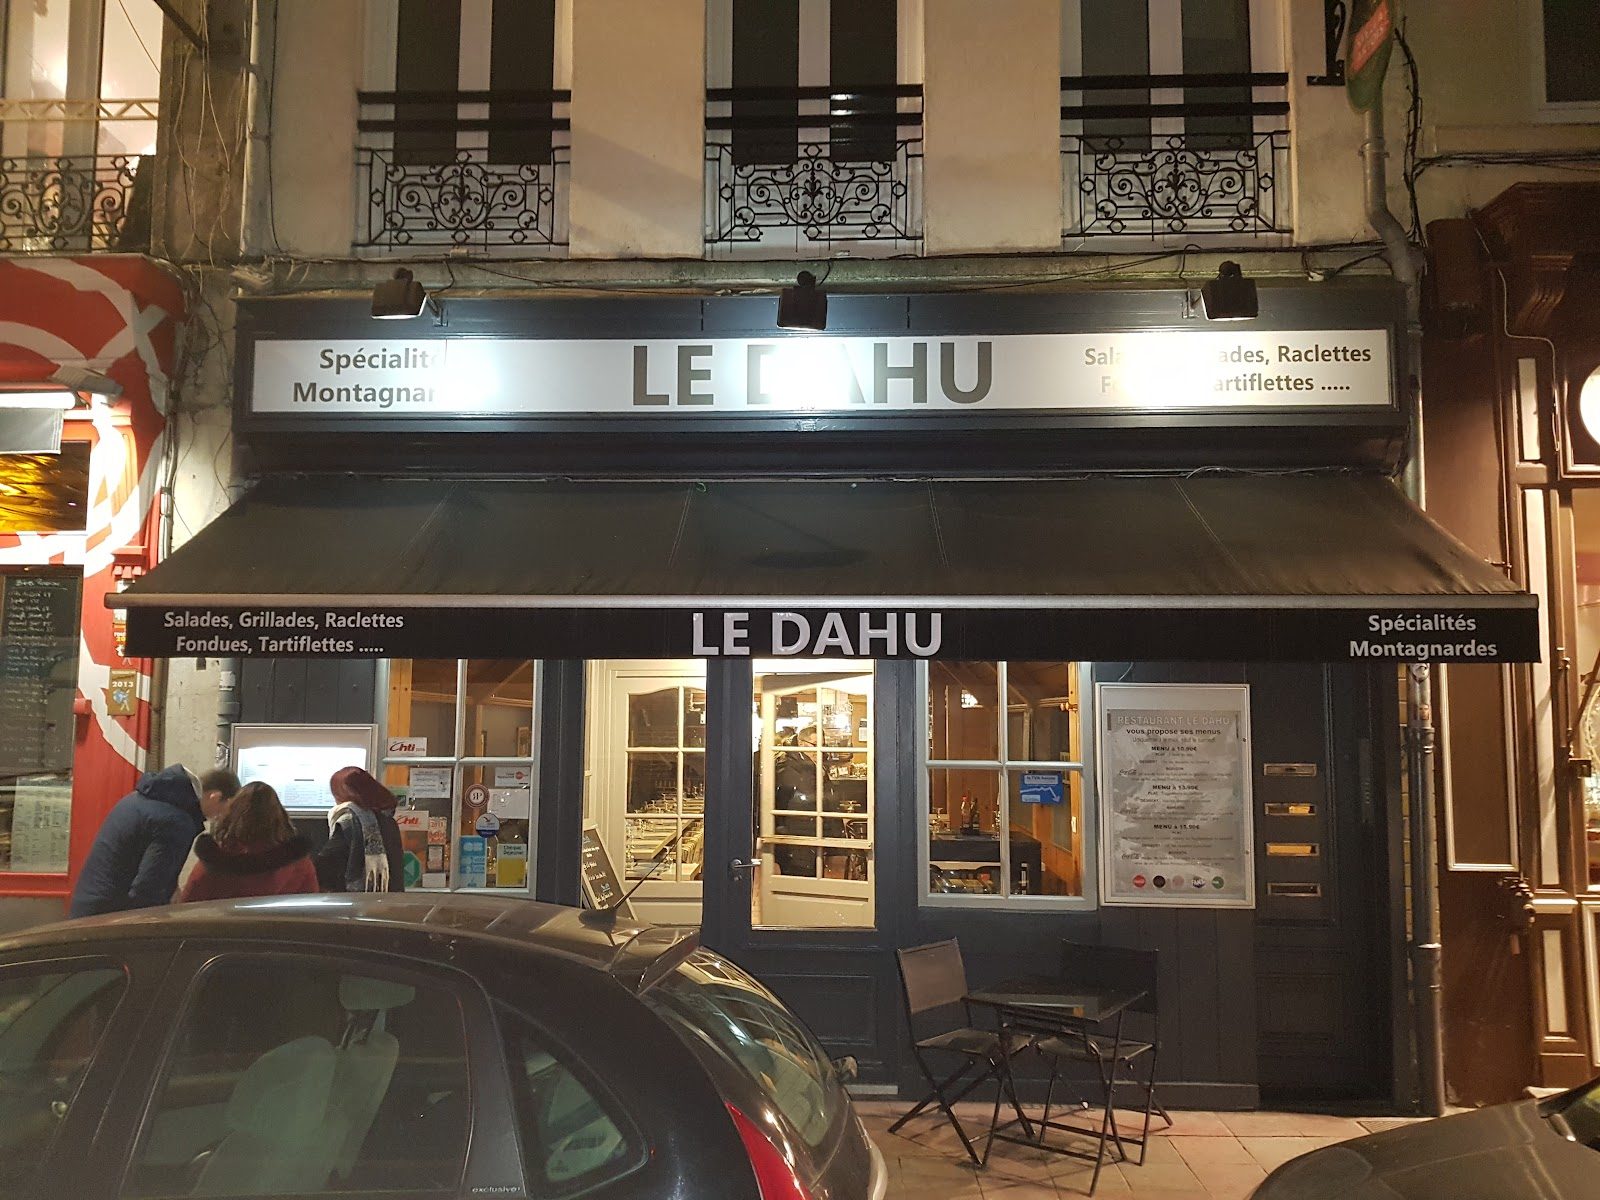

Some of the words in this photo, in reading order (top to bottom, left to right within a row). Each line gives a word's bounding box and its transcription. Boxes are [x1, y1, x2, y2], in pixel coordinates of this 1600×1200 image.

[319, 347, 437, 375] Spécialit
[1278, 344, 1372, 363] Raclettes
[633, 345, 713, 405] LE
[1214, 373, 1315, 392] artiflettes
[293, 381, 437, 409] Montagnar
[163, 611, 234, 630] Salades,
[238, 611, 320, 630] Grillades,
[325, 611, 404, 628] Raclettes
[1368, 613, 1477, 636] Spécialités
[176, 635, 253, 655] Fondues,
[258, 635, 354, 652] Tartiflettes
[692, 612, 750, 656] LE
[771, 612, 942, 657] DAHU
[1350, 639, 1498, 661] Montagnardes
[1117, 716, 1183, 725] RESTAURANT
[1187, 716, 1200, 725] LE
[1146, 728, 1178, 736] propose
